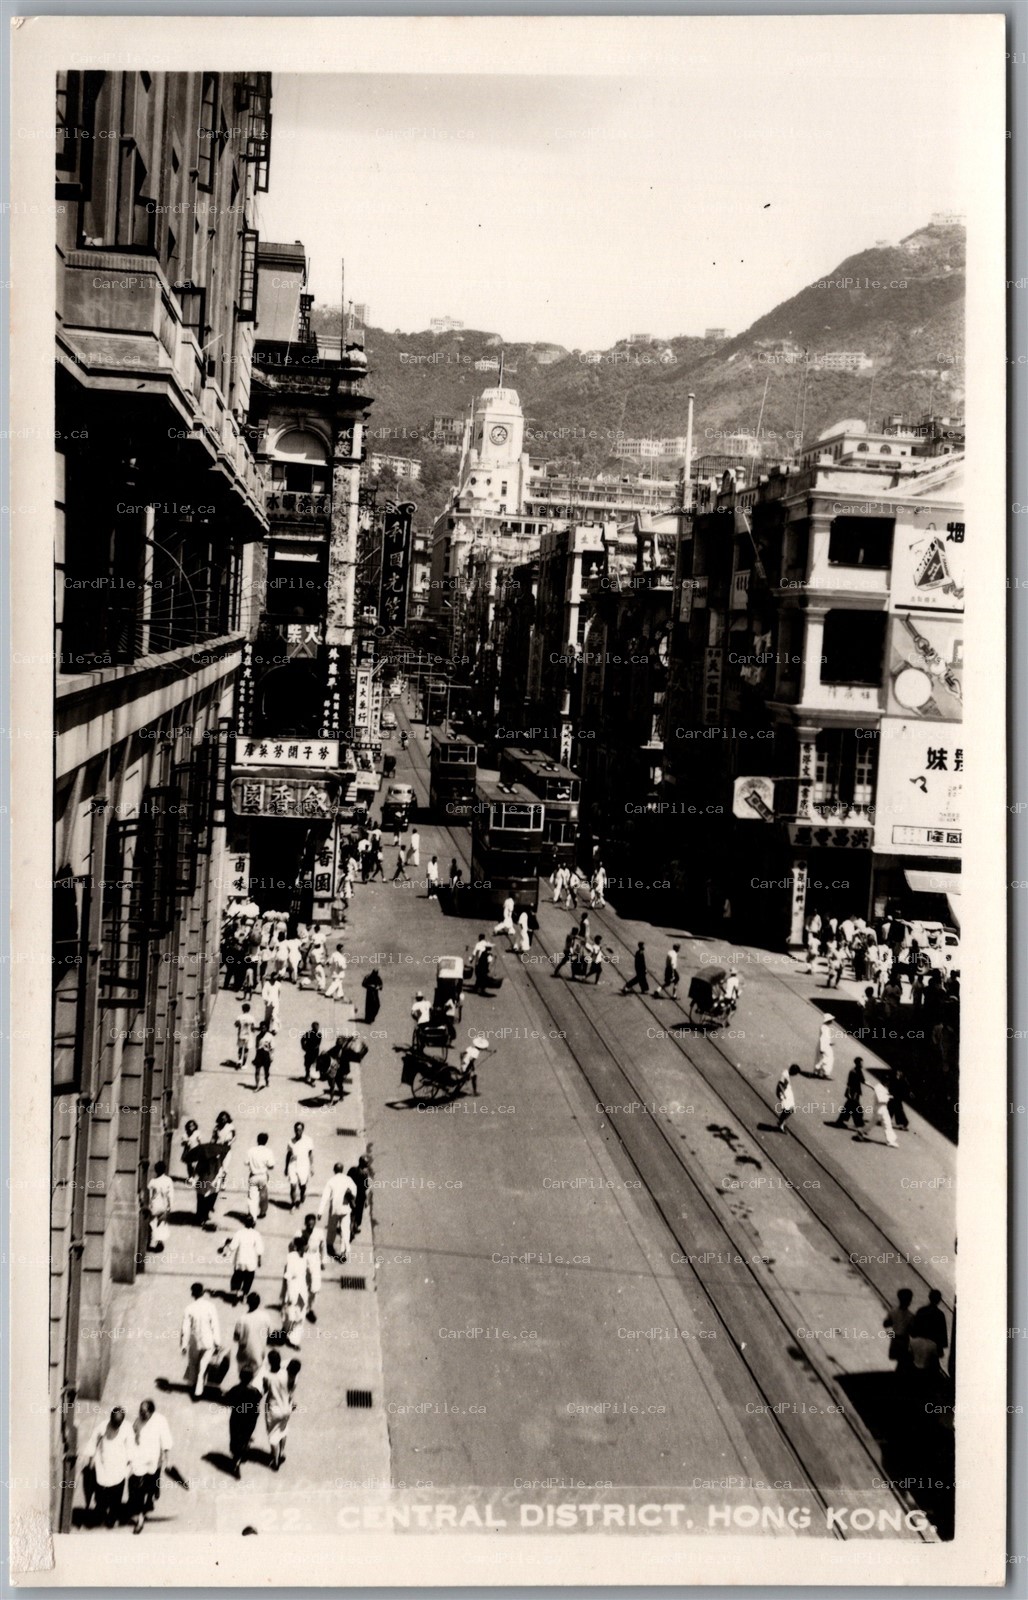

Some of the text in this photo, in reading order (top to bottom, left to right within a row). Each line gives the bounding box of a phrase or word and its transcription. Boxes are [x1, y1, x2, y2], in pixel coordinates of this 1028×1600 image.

[384, 520, 408, 620] 利國光管
[315, 834, 333, 892] 香園
